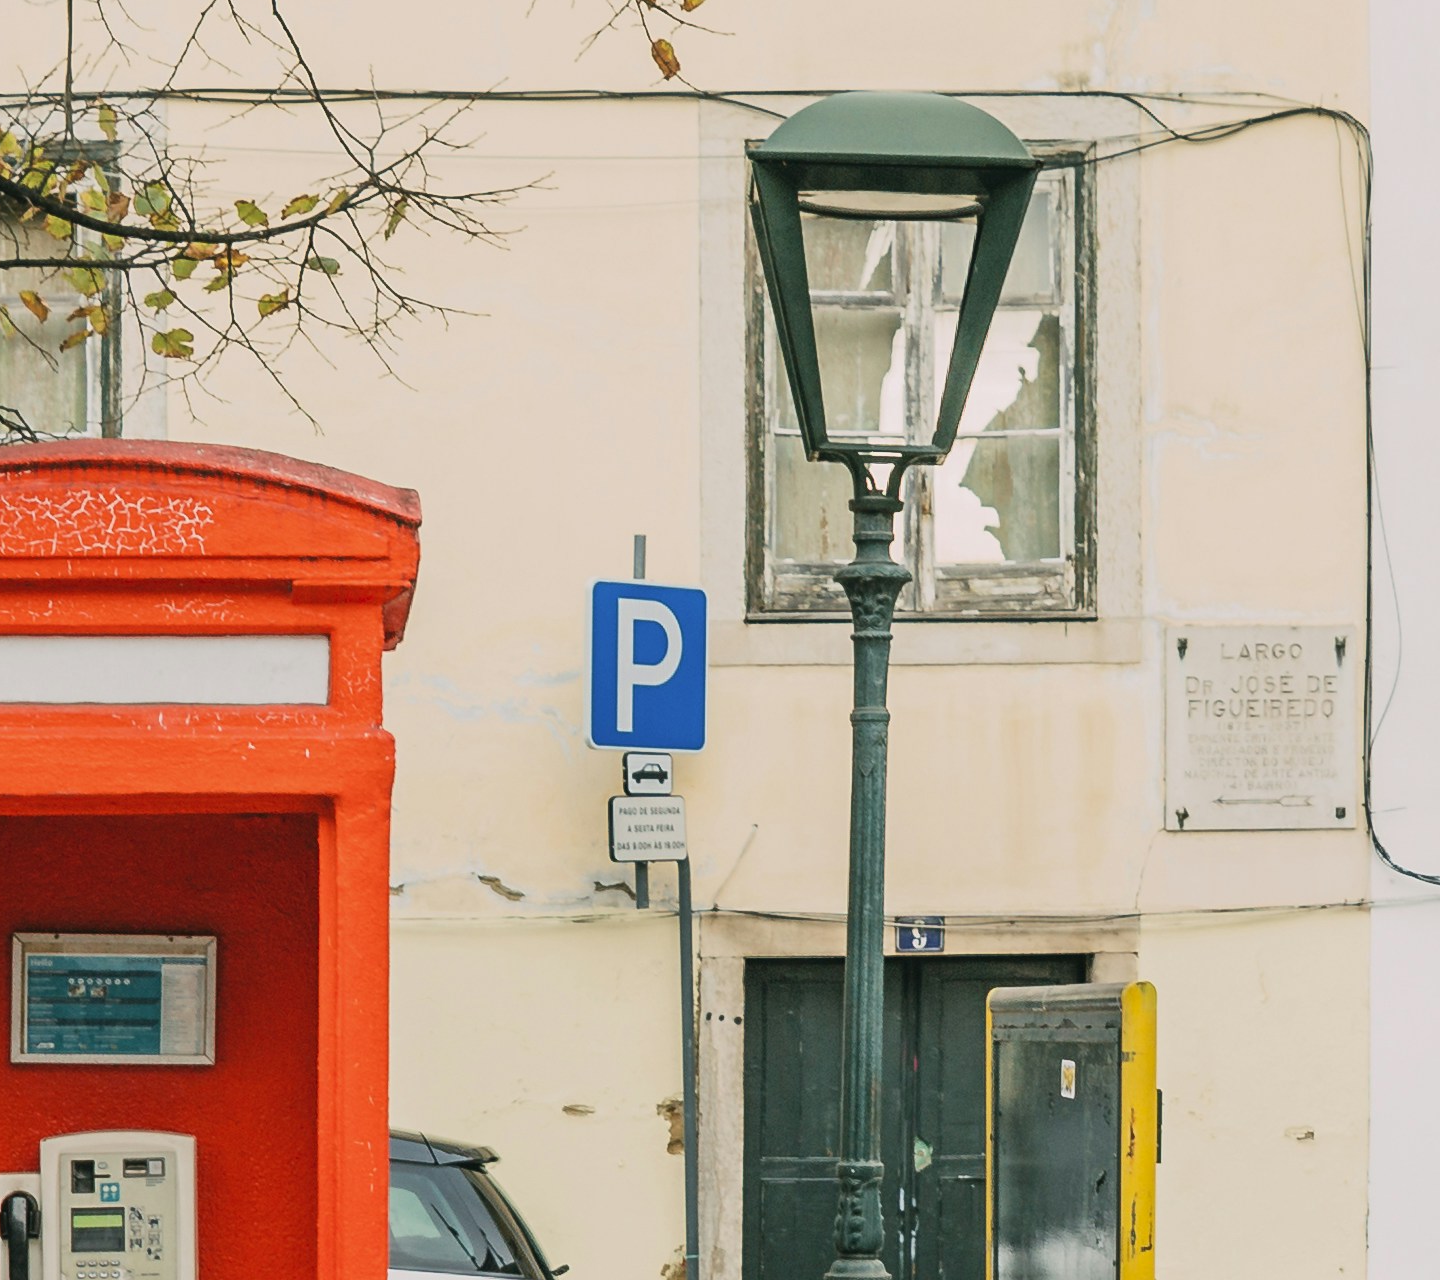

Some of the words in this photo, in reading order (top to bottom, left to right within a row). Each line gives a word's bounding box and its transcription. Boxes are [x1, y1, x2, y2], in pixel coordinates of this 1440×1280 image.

[1220, 642, 1303, 661] LARGO
[616, 597, 683, 733] P
[1230, 671, 1294, 695] JOSÉ
[1307, 675, 1338, 694] DE
[1187, 698, 1335, 719] FIGUEIREDO
[639, 806, 648, 816] DE
